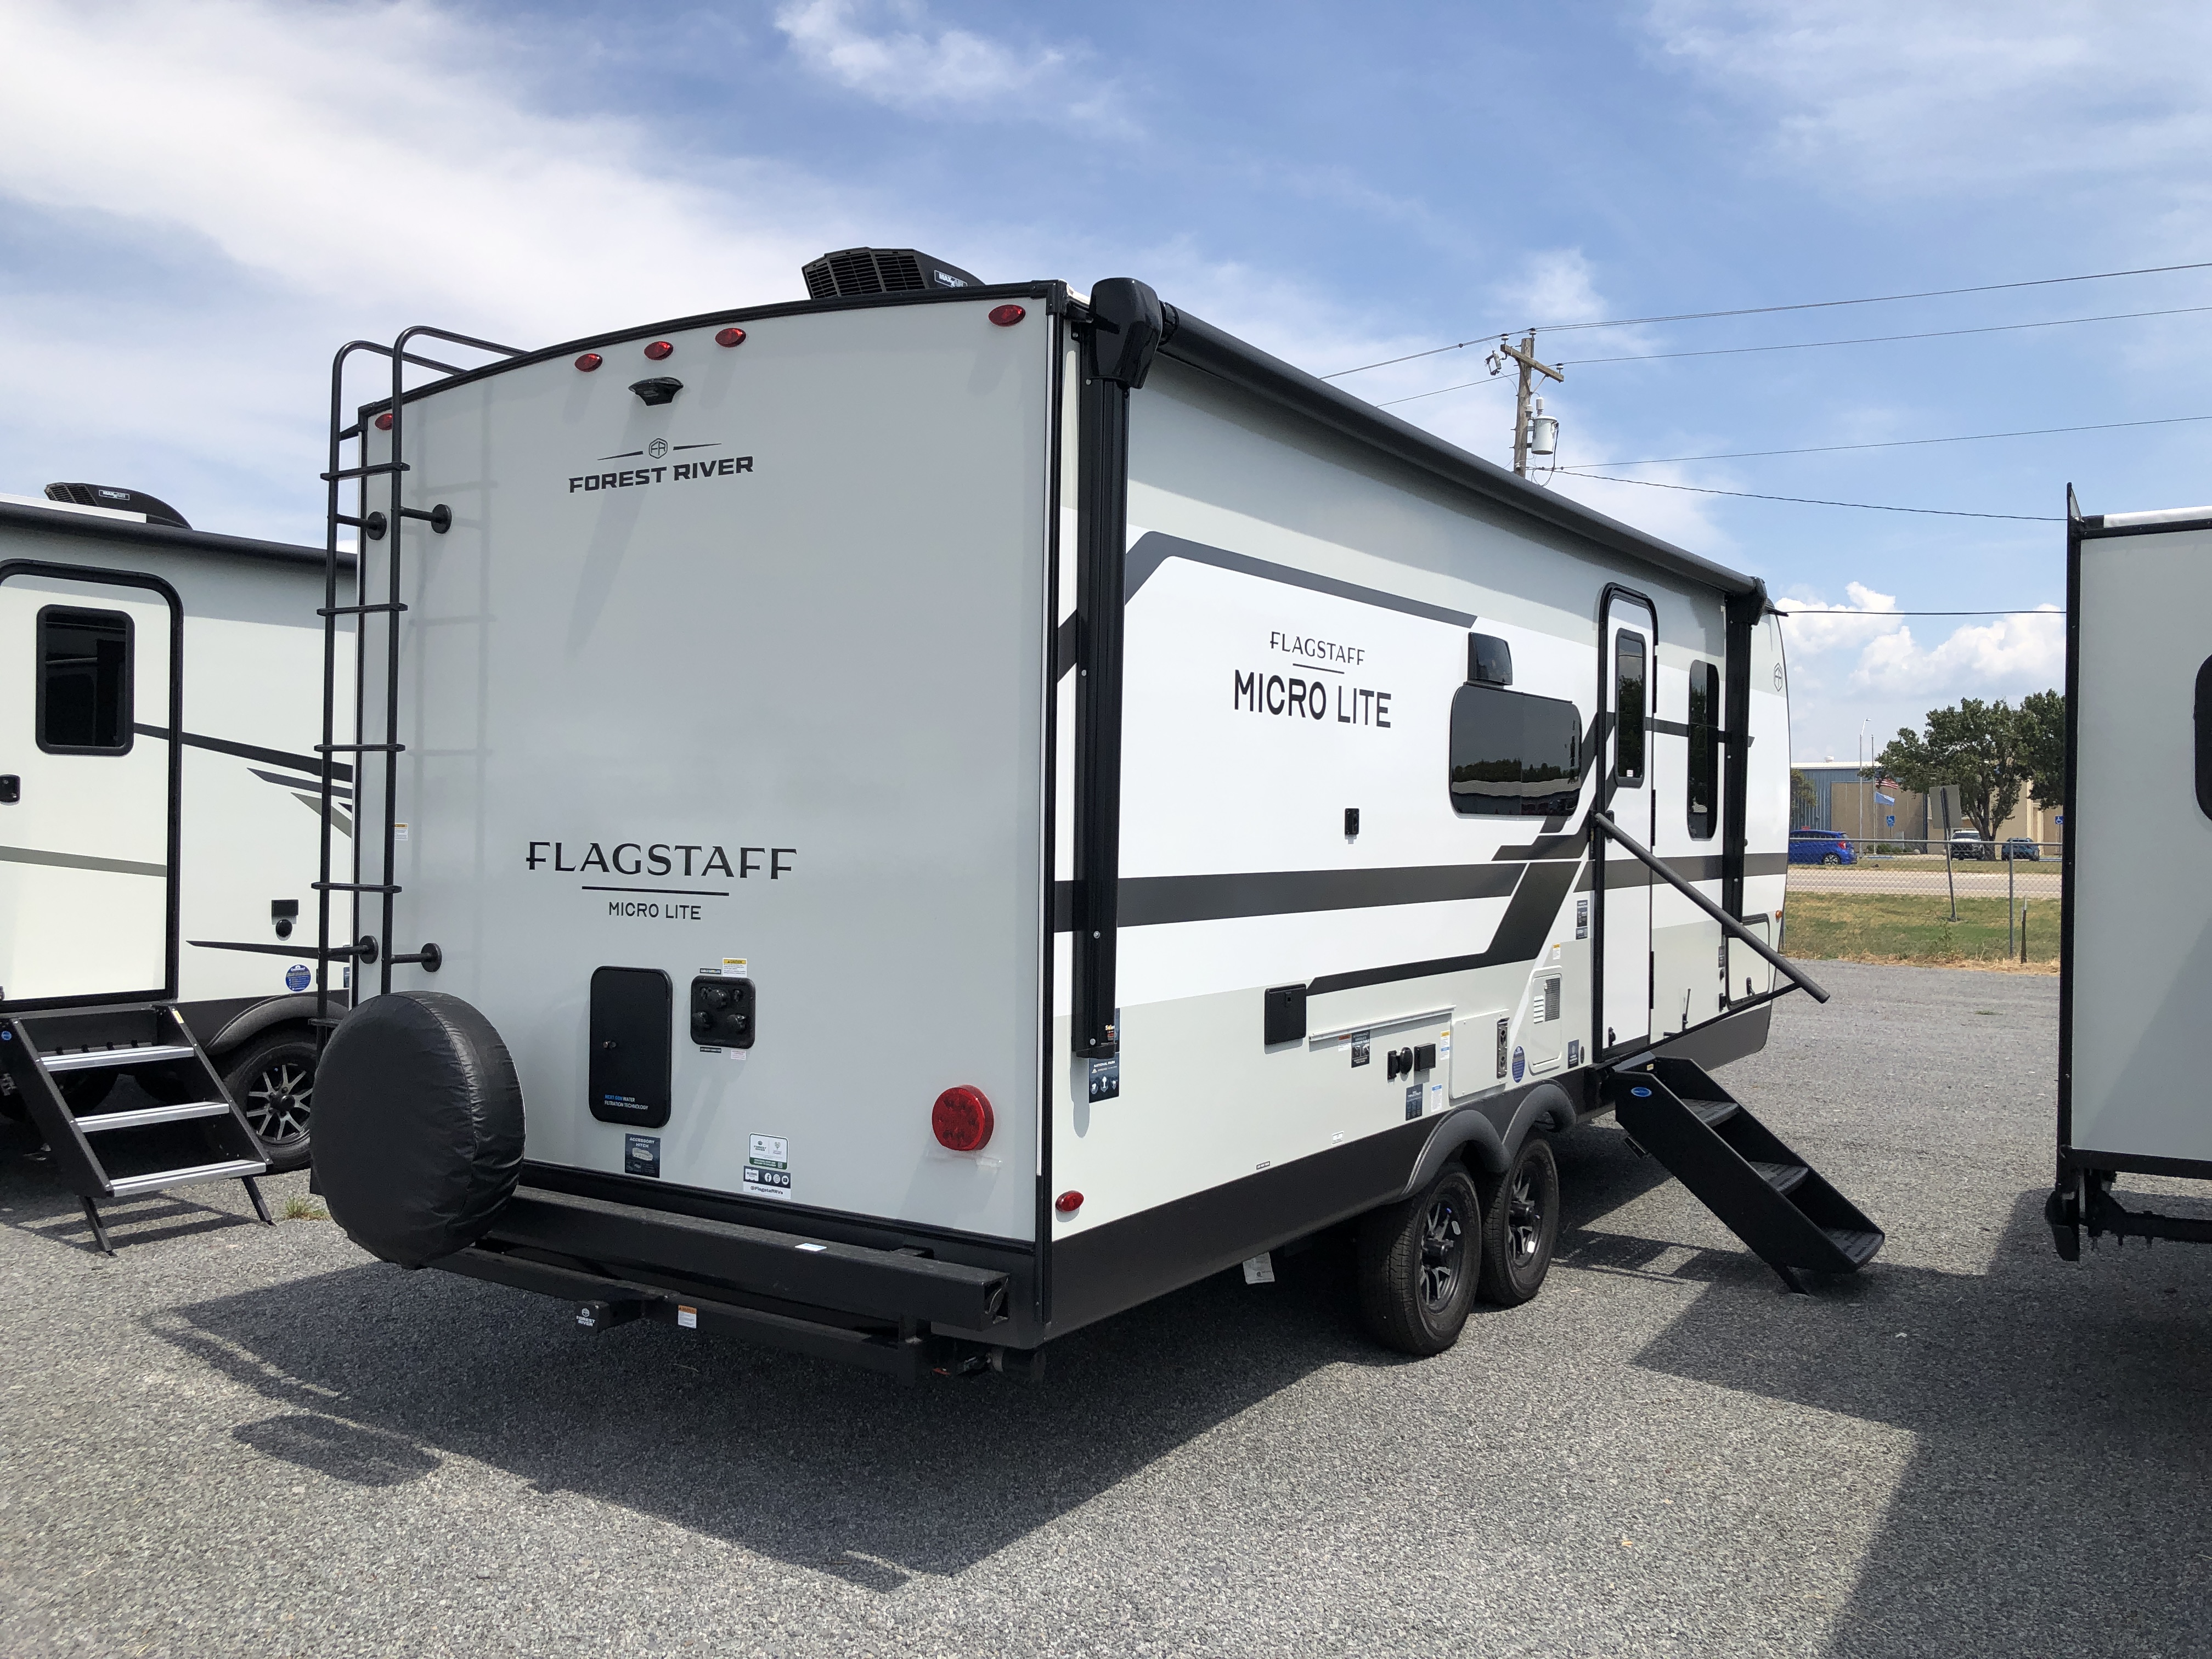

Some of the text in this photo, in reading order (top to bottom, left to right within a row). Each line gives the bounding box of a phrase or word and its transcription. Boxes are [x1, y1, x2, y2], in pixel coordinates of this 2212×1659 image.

[568, 456, 754, 493] FOREST RIVER
[1269, 631, 1365, 665] FLAGSTAFF
[1234, 669, 1391, 728] MICRO LITE
[526, 841, 797, 880] FLAGSTAFF
[608, 901, 701, 920] MICRO LITE
[750, 1186, 783, 1195] @FlagstaffRVs
